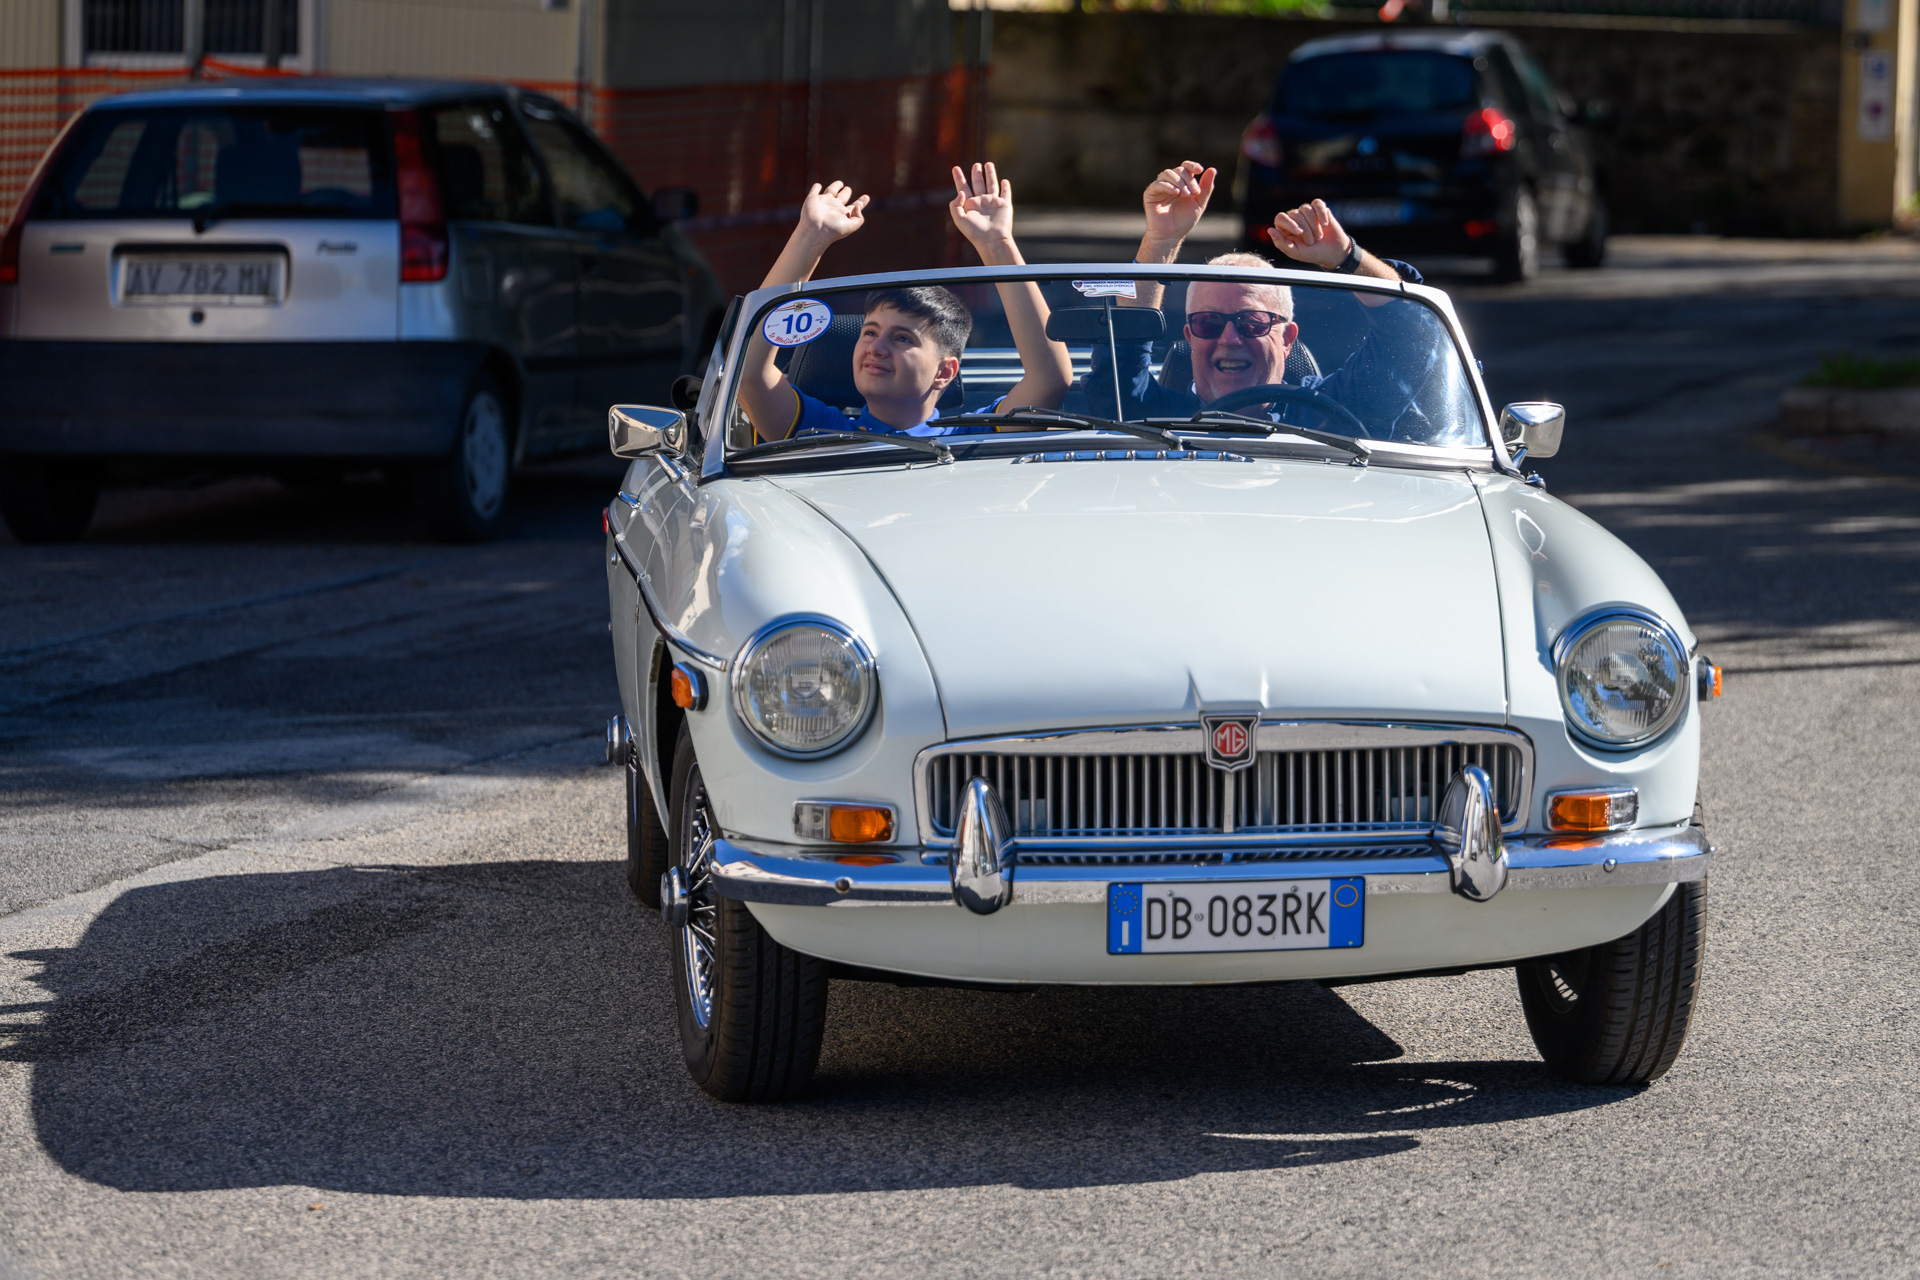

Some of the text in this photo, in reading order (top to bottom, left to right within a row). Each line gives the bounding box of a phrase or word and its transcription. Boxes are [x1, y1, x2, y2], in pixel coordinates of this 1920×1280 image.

[129, 263, 162, 294] AV
[177, 262, 229, 294] 782
[782, 312, 812, 335] 10
[1217, 726, 1245, 753] MG
